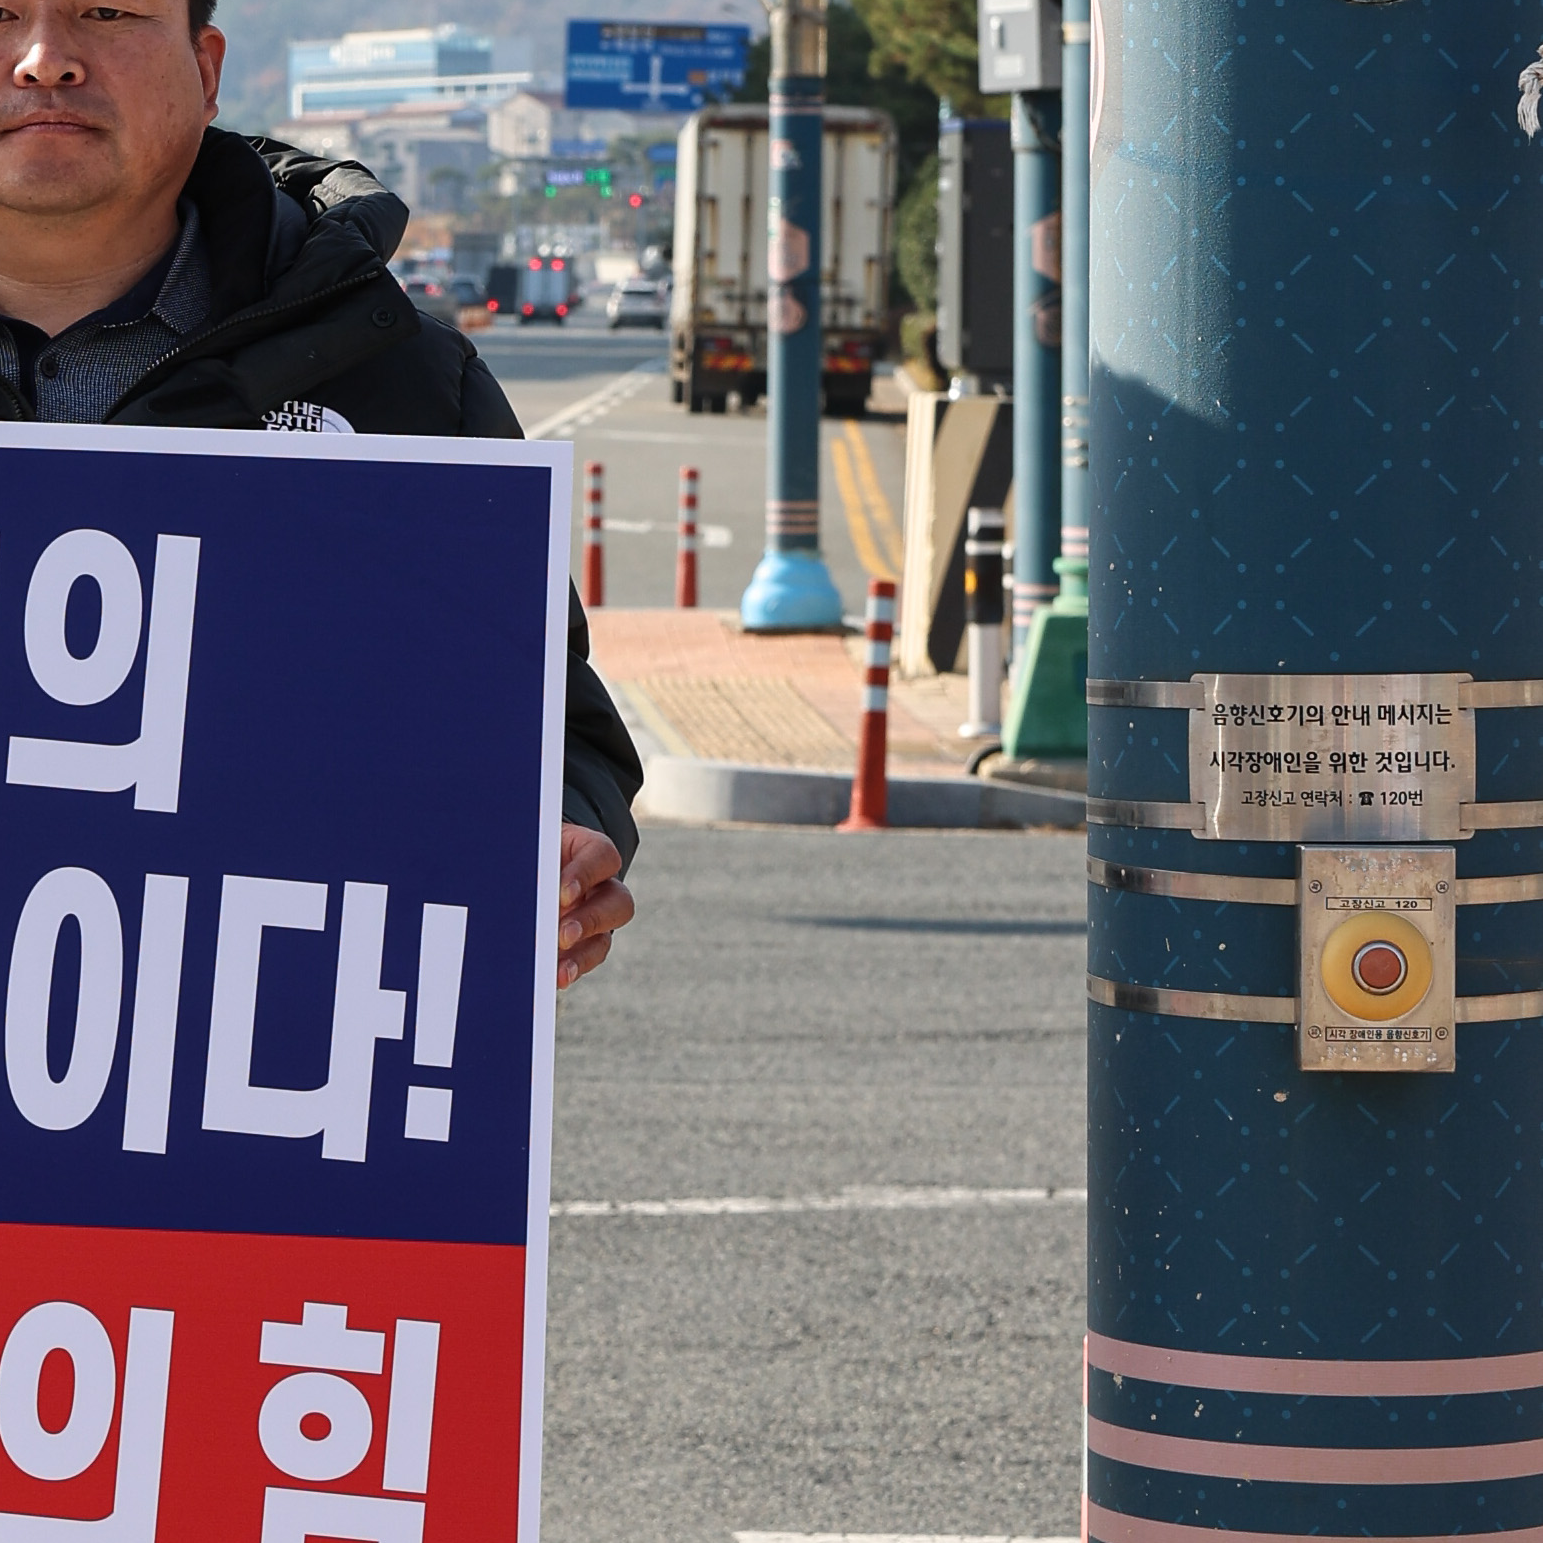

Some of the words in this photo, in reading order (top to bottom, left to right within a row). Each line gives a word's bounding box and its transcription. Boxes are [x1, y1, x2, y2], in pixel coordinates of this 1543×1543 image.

[283, 400, 322, 419] THE
[261, 410, 322, 433] ORTH
[1211, 703, 1324, 727] 음향신호기의
[1331, 704, 1371, 727] 안내
[1377, 703, 1453, 726] 메시지는
[1209, 750, 1322, 774] 시각장애인을
[1328, 750, 1368, 774] 위한
[1375, 750, 1456, 774] 것입니다.
[1241, 790, 1297, 807] 고장신고
[1300, 790, 1343, 807] 연락처
[1379, 790, 1424, 807] 120번
[1339, 899, 1386, 909] 고장신고
[1395, 900, 1418, 909] 120
[1329, 1029, 1346, 1040] 시각
[1386, 1029, 1429, 1040] 음향신호기
